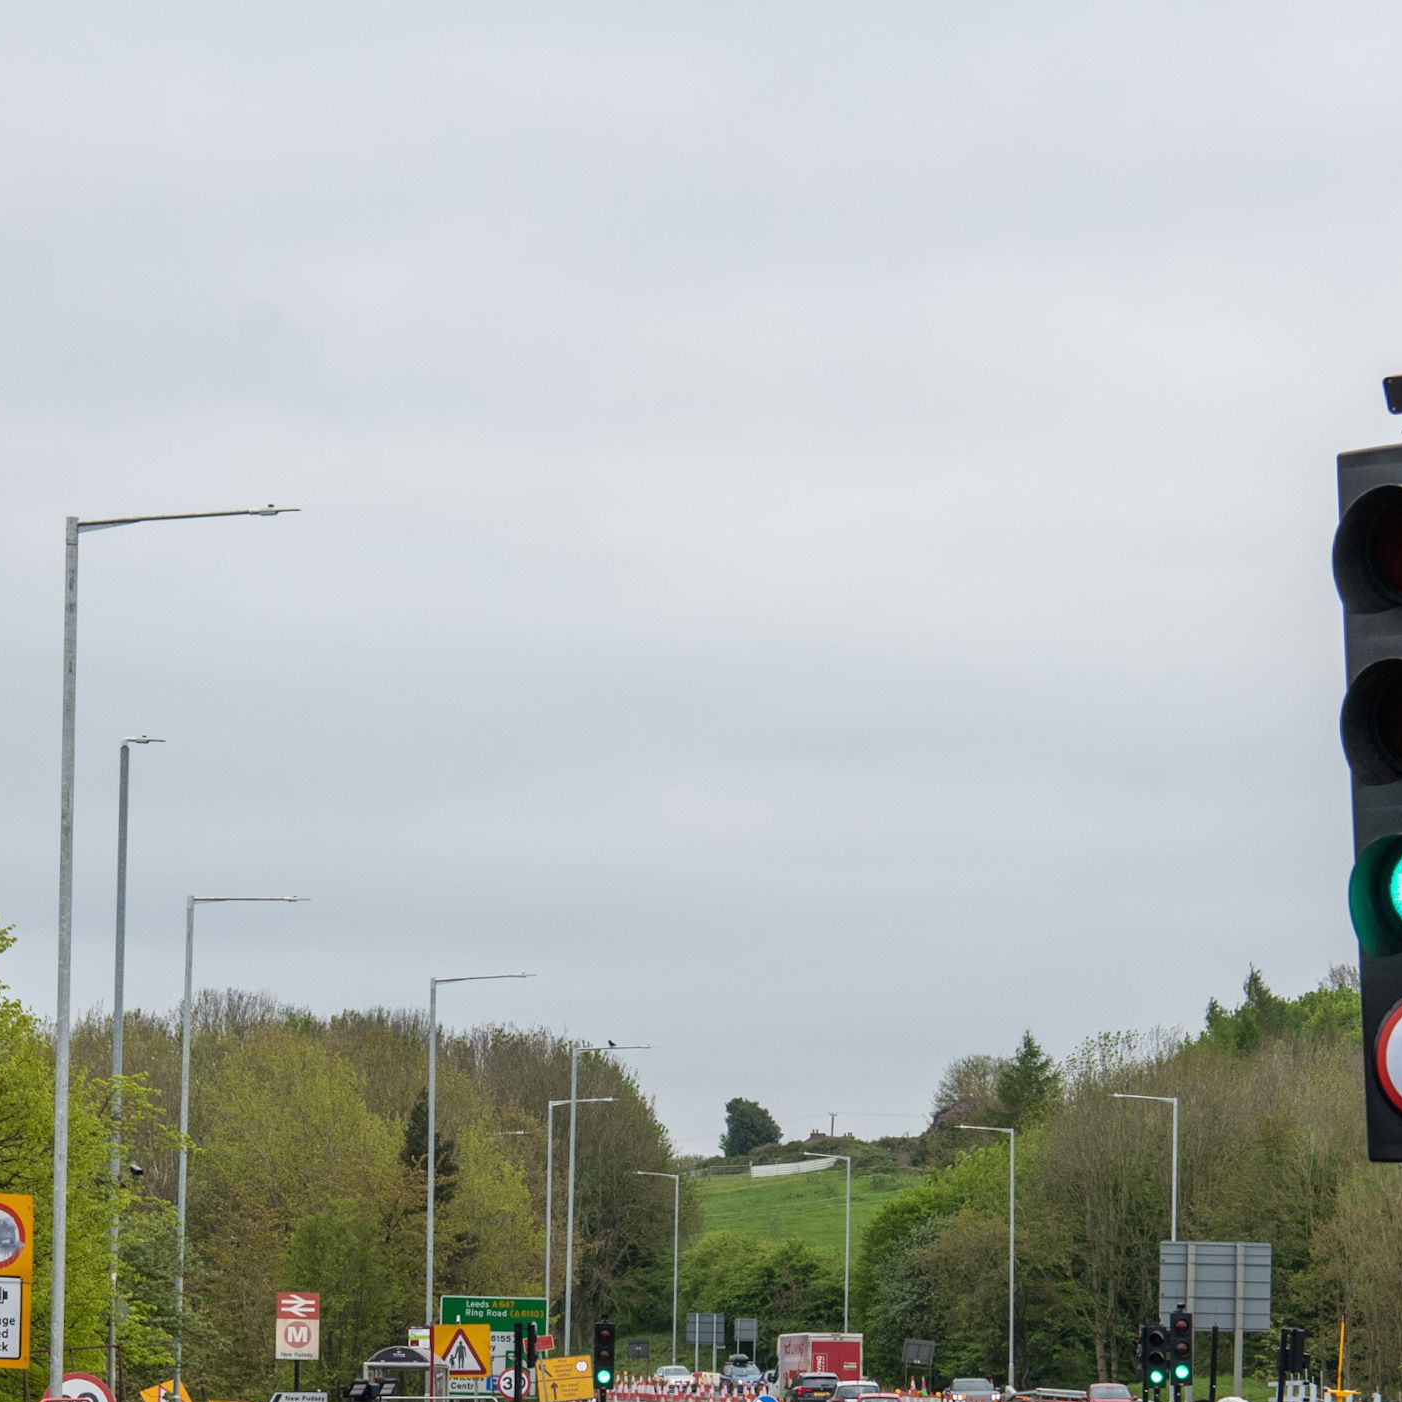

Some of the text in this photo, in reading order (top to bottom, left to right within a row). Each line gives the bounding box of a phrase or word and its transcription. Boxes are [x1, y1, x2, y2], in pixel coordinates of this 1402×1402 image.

[465, 1300, 490, 1308] Leeds
[465, 1309, 484, 1317] Ring
[486, 1309, 508, 1317] Road
[287, 1326, 308, 1343] M
[450, 1382, 474, 1390] Centr
